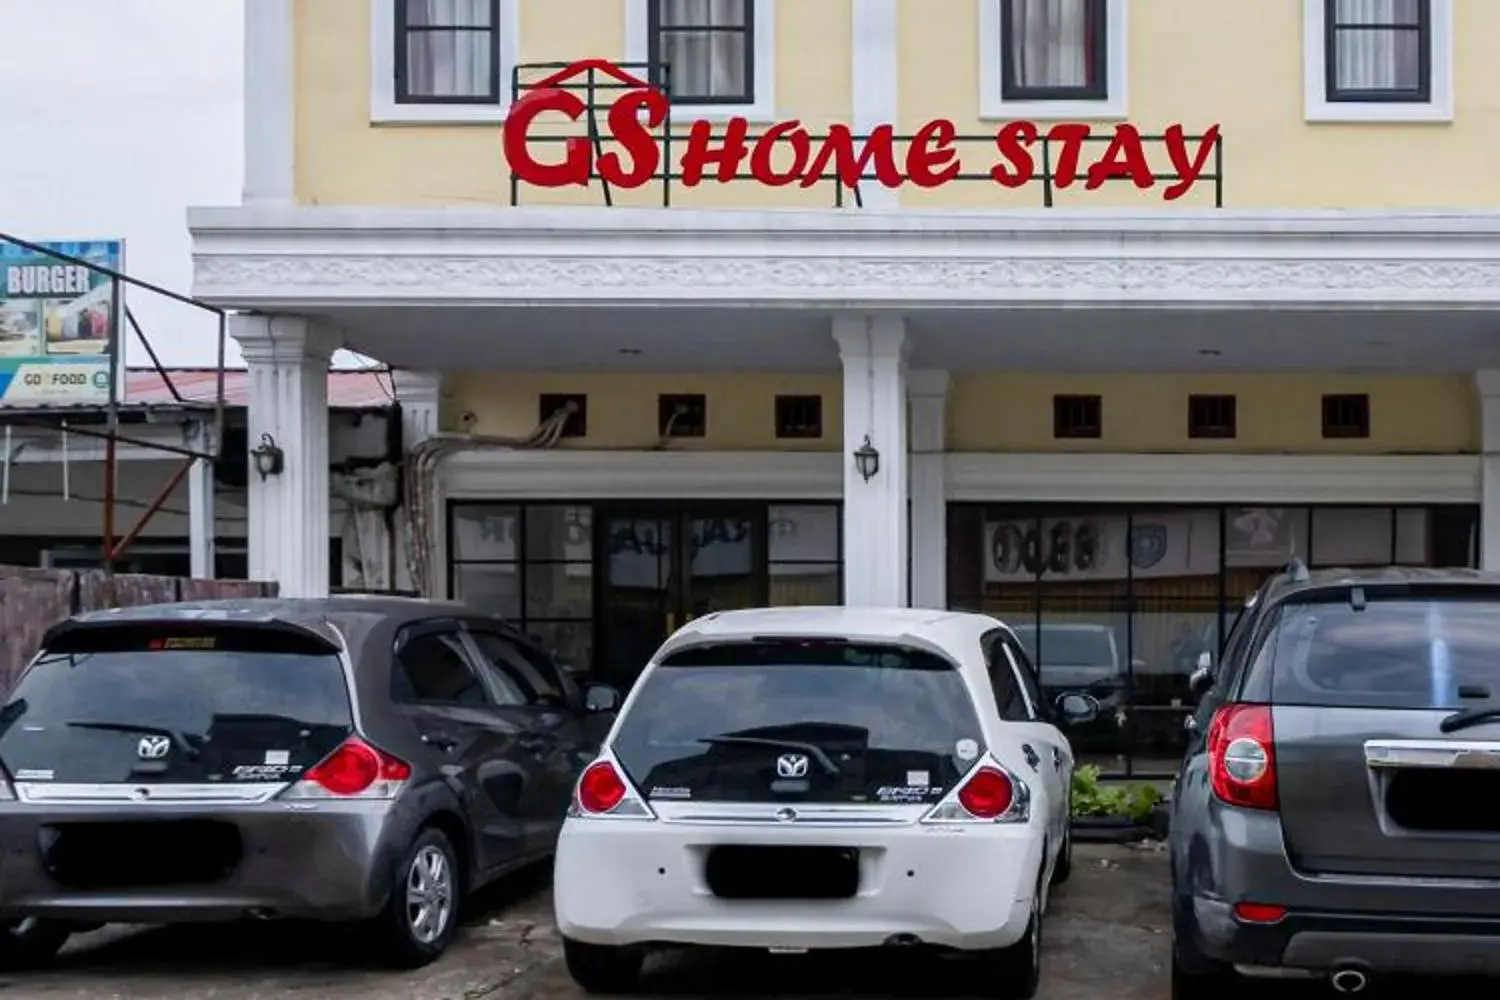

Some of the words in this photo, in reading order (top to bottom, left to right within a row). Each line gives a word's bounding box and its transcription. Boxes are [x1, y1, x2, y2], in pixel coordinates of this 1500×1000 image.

[502, 87, 671, 189] GS
[680, 118, 961, 188] HOME
[991, 121, 1219, 200] STAY
[7, 265, 91, 293] BURGER
